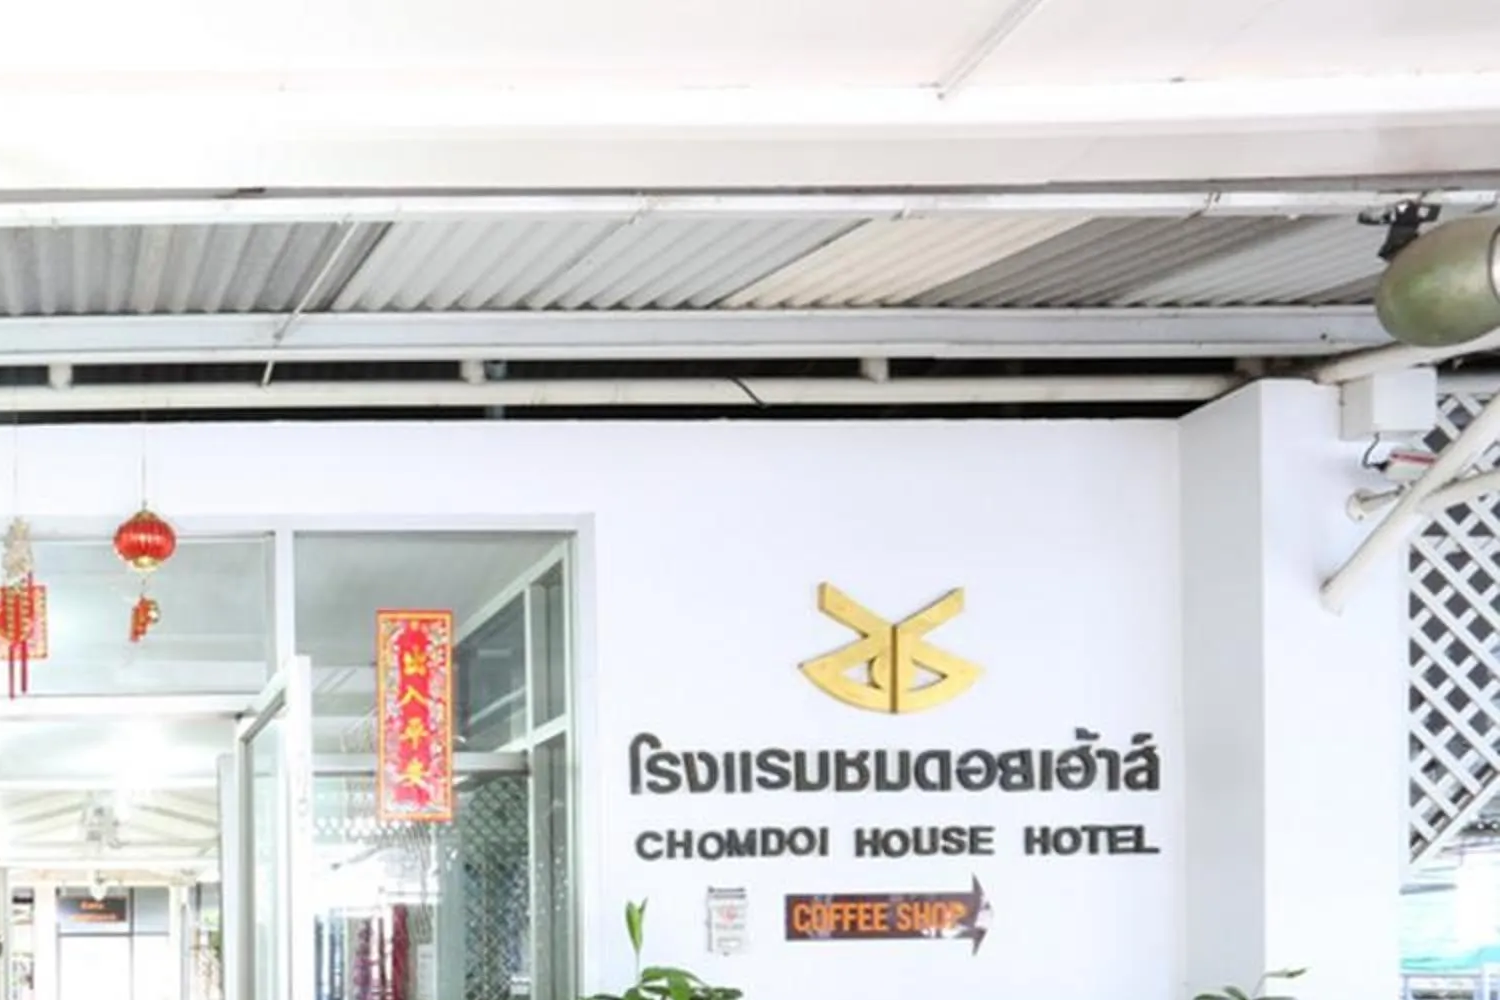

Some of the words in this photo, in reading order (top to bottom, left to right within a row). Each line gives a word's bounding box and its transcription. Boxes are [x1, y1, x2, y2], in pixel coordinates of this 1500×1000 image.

[634, 826, 830, 861] CHOMDOI
[854, 825, 996, 858] HOUSE
[1023, 823, 1162, 856] HOTEL
[792, 902, 889, 932] COFFEE
[897, 901, 968, 932] SHOP
